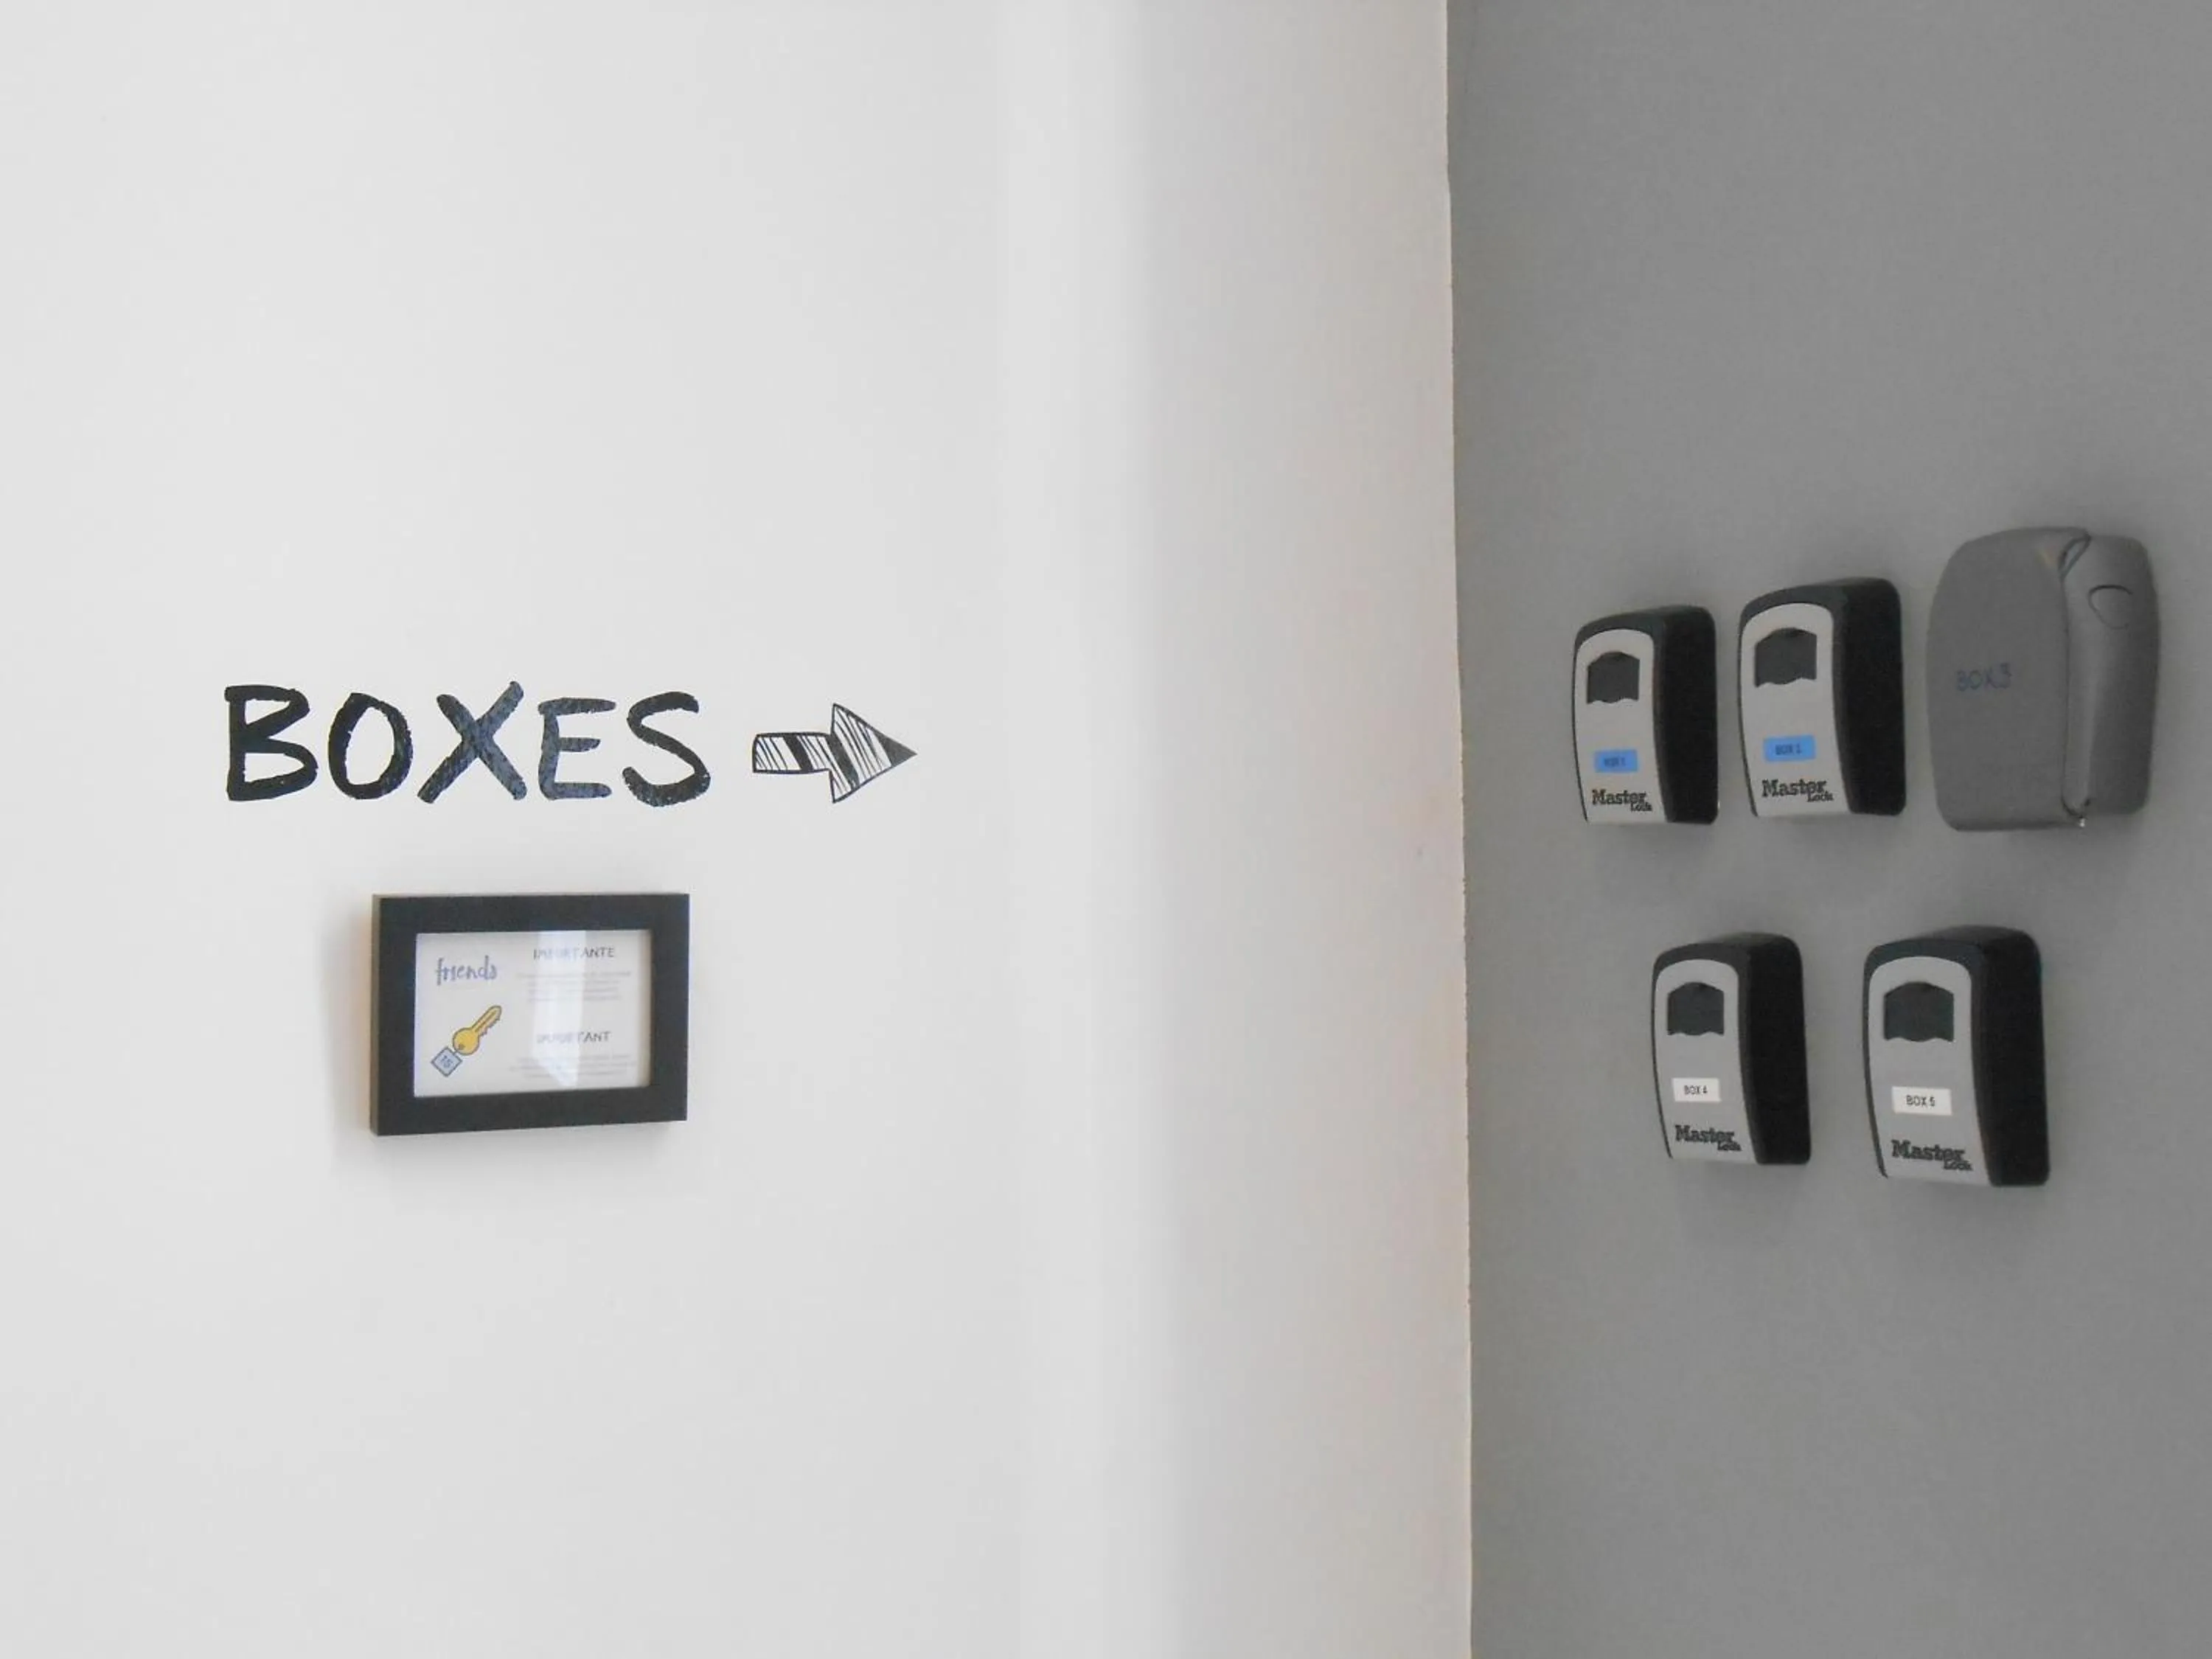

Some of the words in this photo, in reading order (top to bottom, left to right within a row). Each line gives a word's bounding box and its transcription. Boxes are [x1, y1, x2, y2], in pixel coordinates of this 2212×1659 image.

[223, 681, 712, 807] BOXES
[1591, 788, 1646, 805] Master
[1761, 779, 1827, 799] Master
[1807, 792, 1834, 802] Lock
[1630, 801, 1652, 812] Lock
[533, 946, 616, 960] IMPORTANTE
[435, 954, 498, 986] friends
[1683, 1085, 1701, 1096] BOX
[1703, 1085, 1708, 1095] 4
[1905, 1094, 1927, 1107] BOX
[1929, 1095, 1935, 1107] 5
[1674, 1124, 1736, 1144] Master
[1717, 1140, 1742, 1152] Lock
[1891, 1138, 1966, 1162] Master
[1943, 1157, 1973, 1172] Lock
